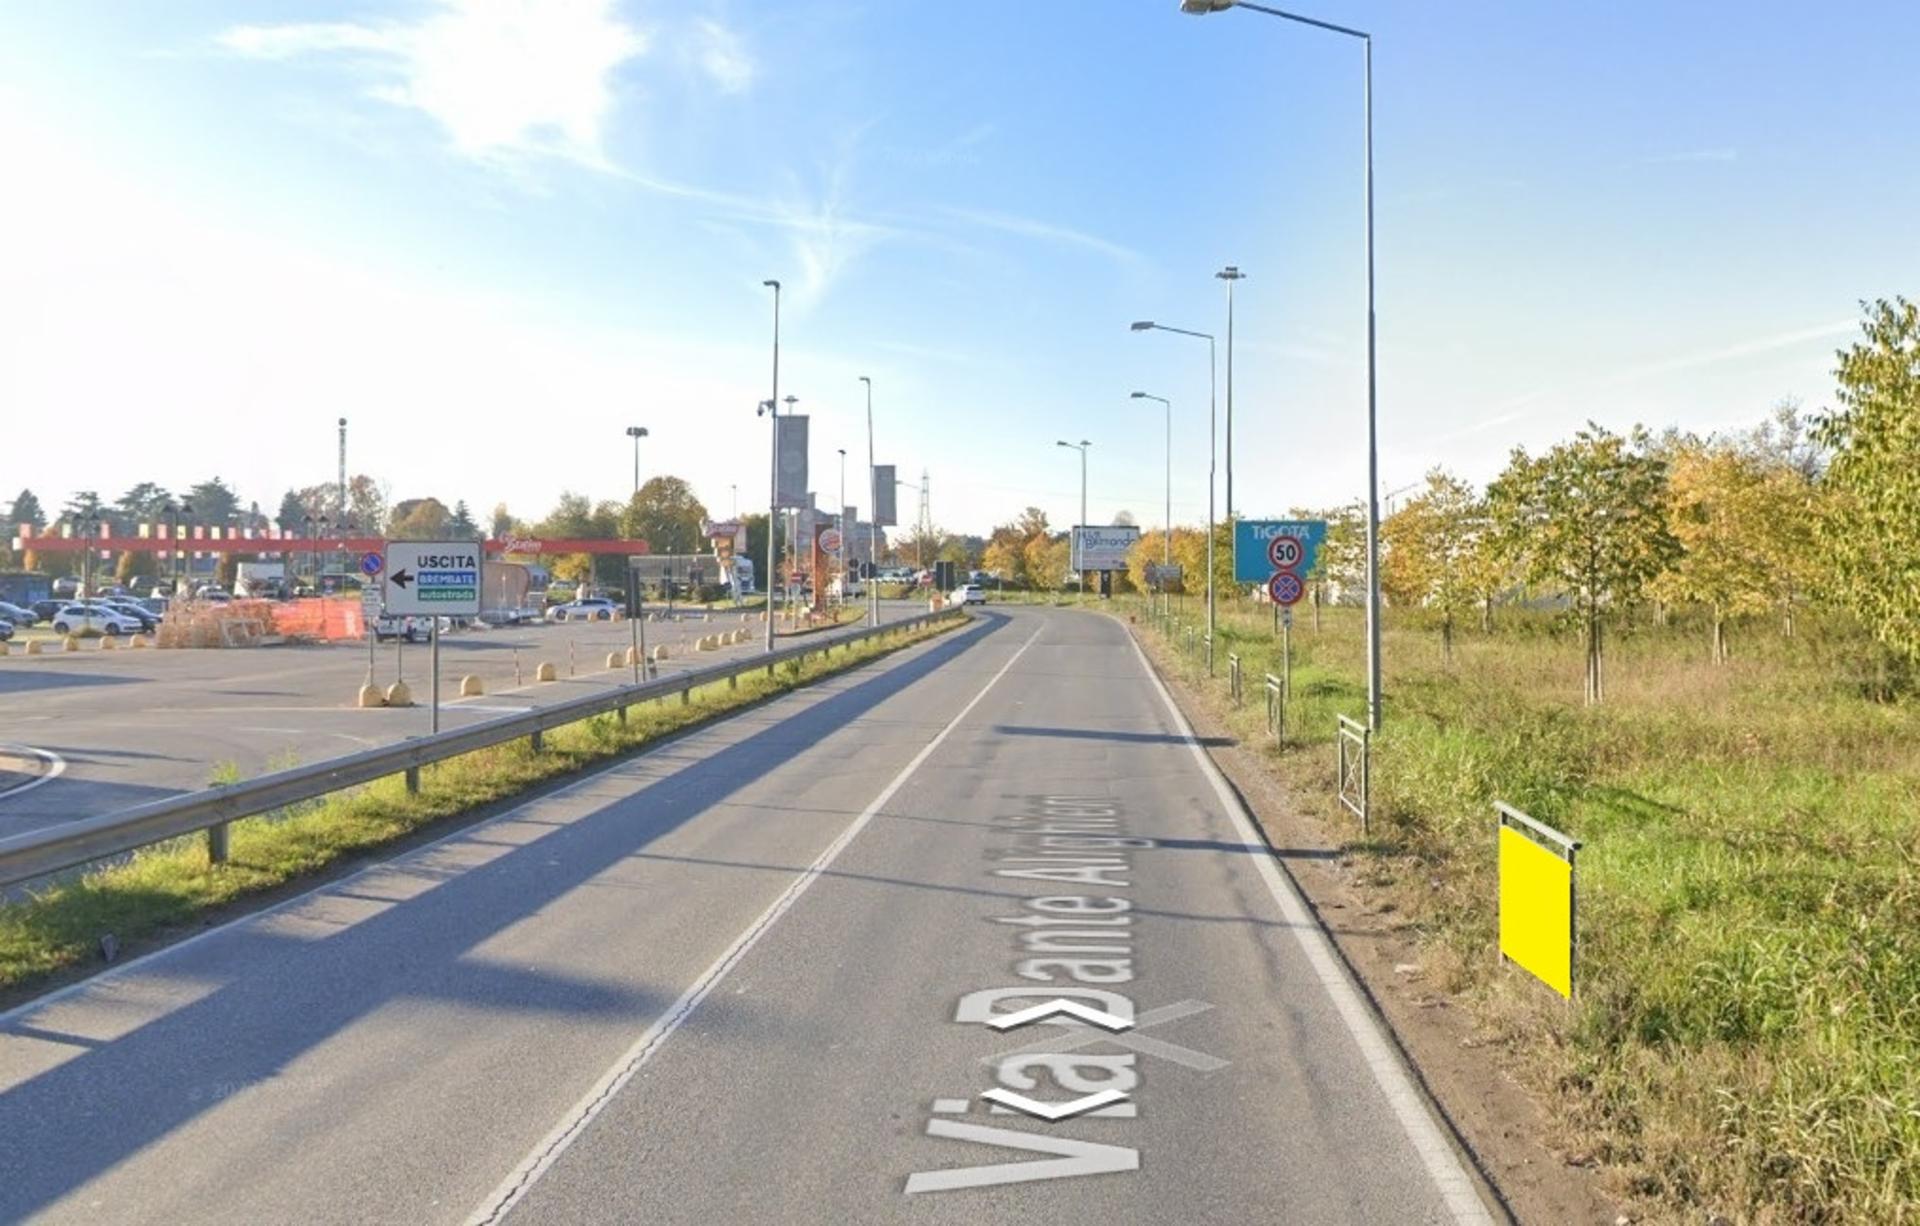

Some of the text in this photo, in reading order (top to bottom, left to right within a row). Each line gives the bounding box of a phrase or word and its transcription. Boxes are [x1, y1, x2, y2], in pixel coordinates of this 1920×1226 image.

[1276, 544, 1296, 561] 50
[417, 555, 476, 568] USCITA
[419, 574, 474, 585] BREMBATE
